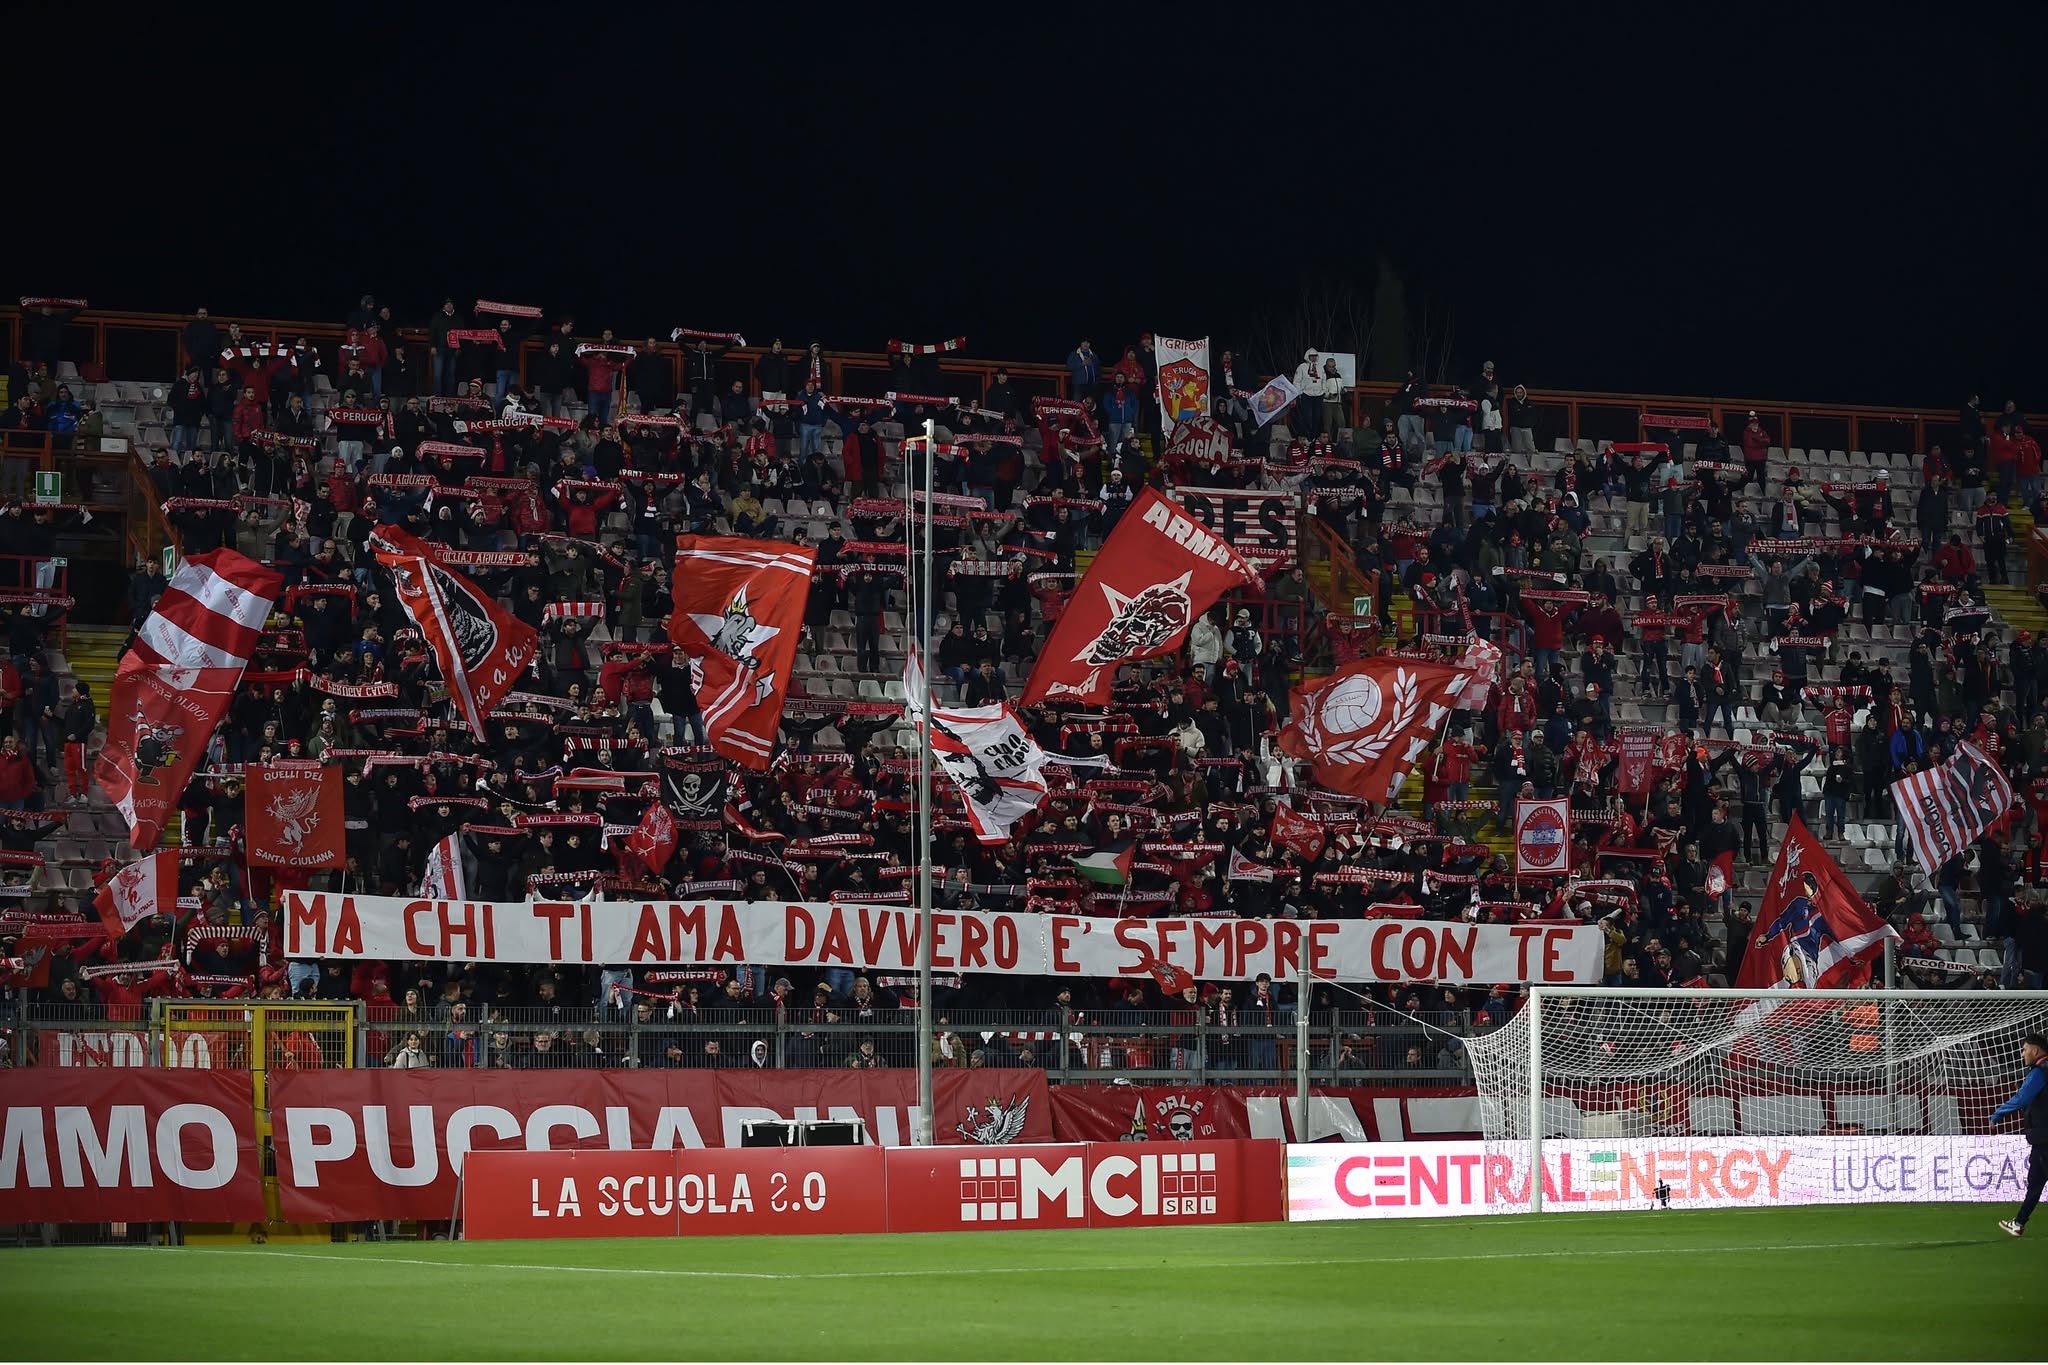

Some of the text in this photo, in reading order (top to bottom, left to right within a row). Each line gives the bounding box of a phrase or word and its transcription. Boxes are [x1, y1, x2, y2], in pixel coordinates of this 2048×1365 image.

[470, 417, 529, 430] AC PERUGIA
[1790, 636, 1822, 645] PERUGIA
[264, 770, 324, 782] QUELLI DEL
[526, 814, 591, 823] WILD BOYS
[255, 847, 336, 866] SANTA GIULIANA
[288, 892, 1575, 982] MA CHI TI AMA DAVVERO E' SEMPRE CON TE
[1155, 1095, 1205, 1117] DALE
[1199, 1123, 1217, 1136] VDL
[1832, 1154, 1917, 1192] LUCE
[1933, 1155, 1950, 1191] E
[532, 1177, 582, 1218] LA
[598, 1172, 755, 1216] SCUOLA
[1020, 1153, 1159, 1219] MCI
